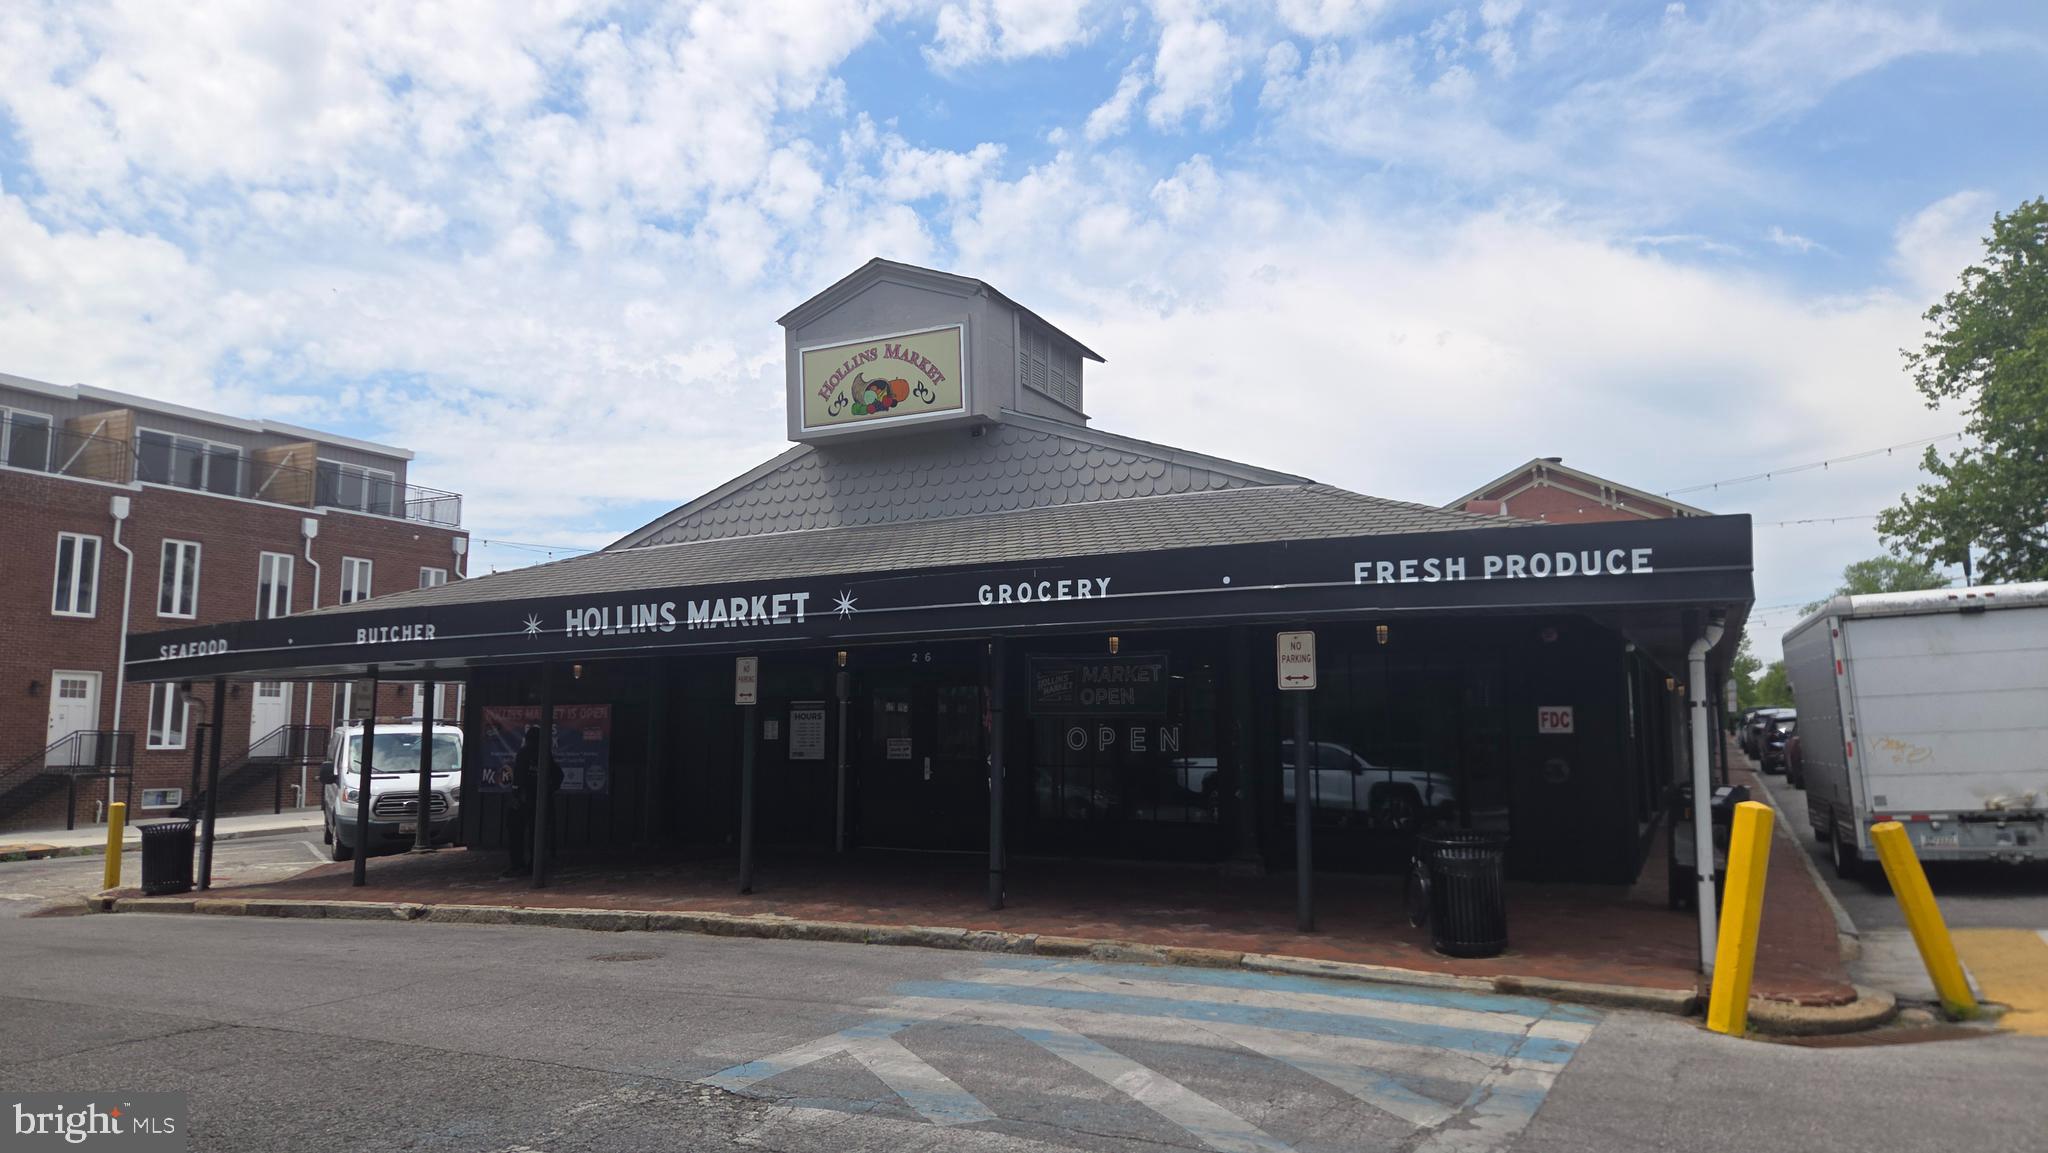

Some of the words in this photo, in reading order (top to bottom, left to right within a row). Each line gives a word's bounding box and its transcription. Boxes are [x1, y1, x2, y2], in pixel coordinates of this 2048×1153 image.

[817, 347, 878, 402] HOLLINS
[883, 343, 946, 386] MARKET
[1354, 556, 1466, 585] FRESH
[1483, 547, 1654, 580] PRODUCE
[978, 577, 1112, 606] GROCERY
[566, 601, 677, 638] HOLLINS
[688, 592, 810, 630] MARKET
[356, 623, 436, 645] BUTCHER
[159, 638, 228, 661] SEAFOOD
[1290, 641, 1302, 651] NO
[1281, 653, 1312, 664] PARKING
[1081, 664, 1163, 682] MARKET
[1080, 687, 1136, 705] OPEN
[794, 712, 823, 721] HOURS
[1541, 711, 1570, 728] FDC
[1066, 726, 1180, 752] OPEN
